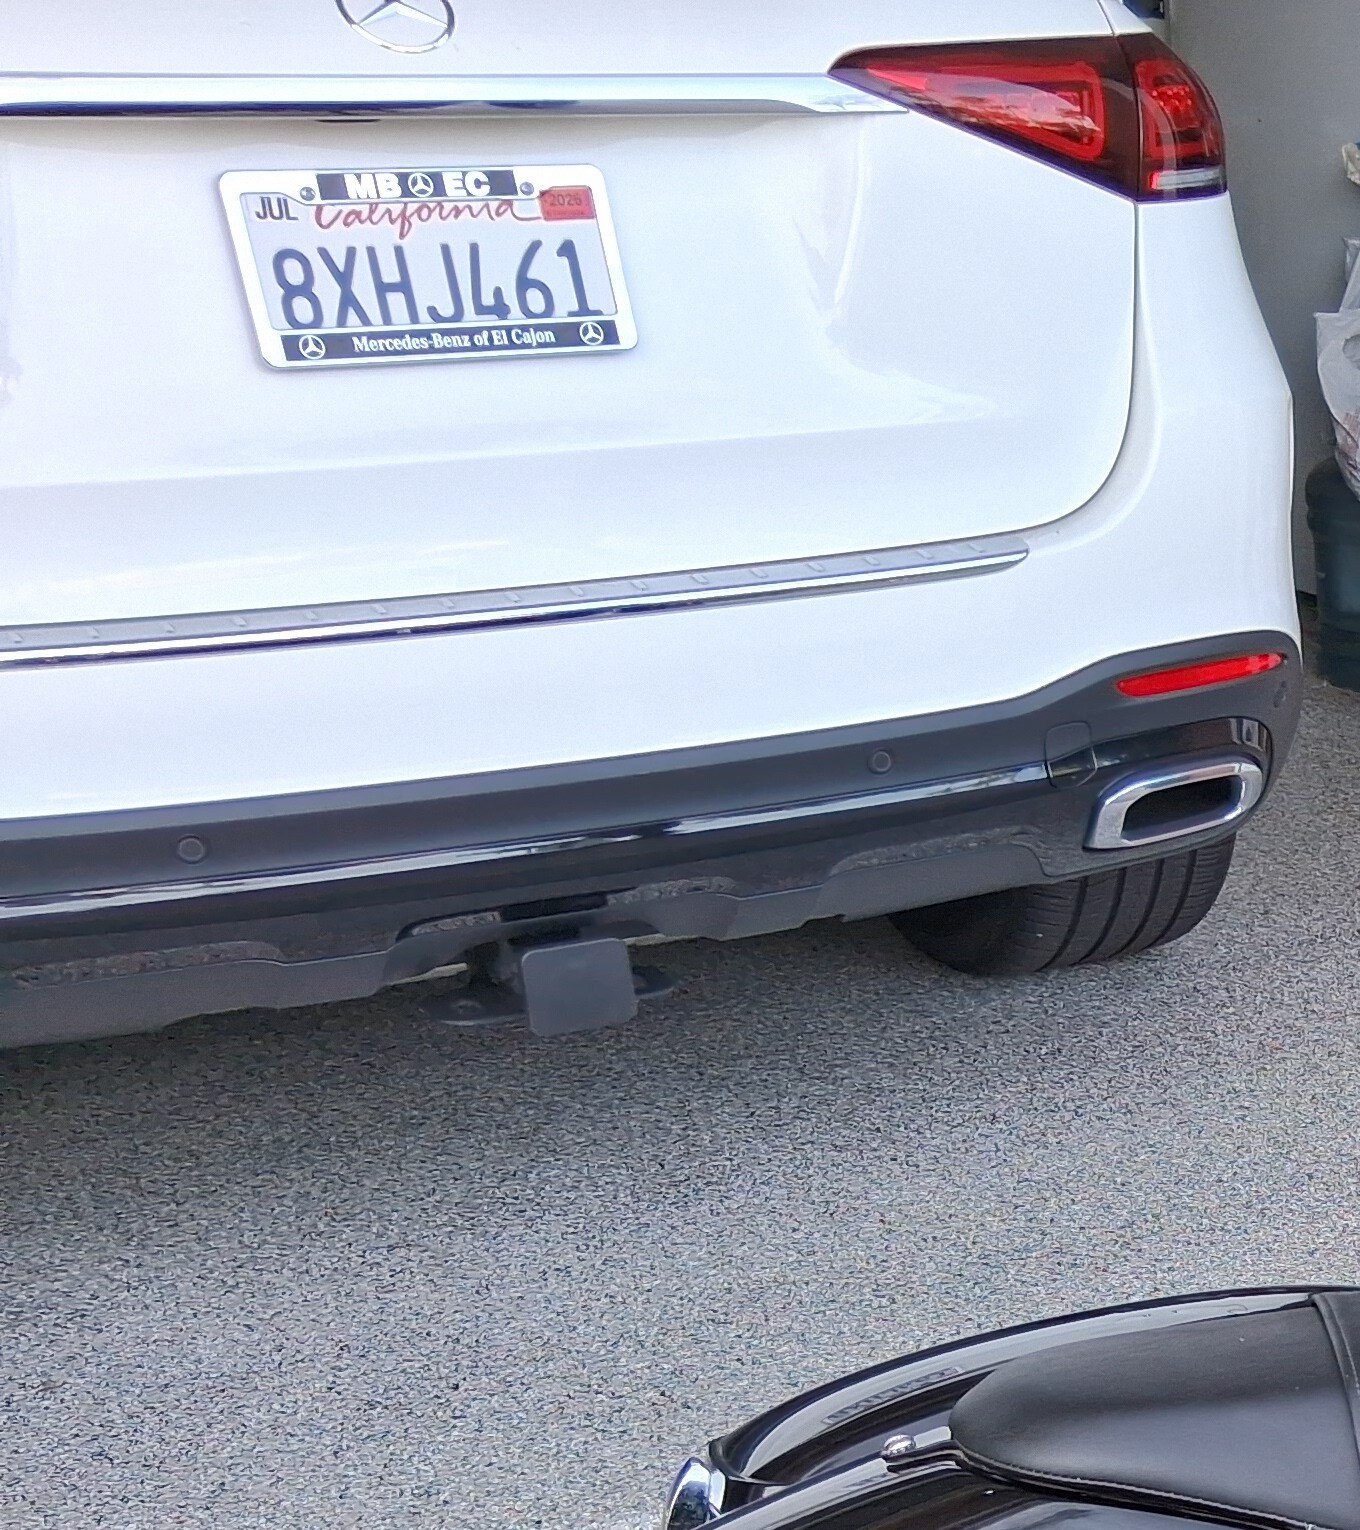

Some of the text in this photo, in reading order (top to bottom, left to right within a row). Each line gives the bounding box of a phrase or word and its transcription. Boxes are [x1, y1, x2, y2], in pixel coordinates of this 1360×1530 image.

[343, 171, 492, 199] MB EC
[255, 196, 298, 222] JUL
[314, 200, 542, 239] California
[273, 239, 604, 329] 8XHJ461
[352, 328, 556, 353] Mercedes-Benz of El Cajon
